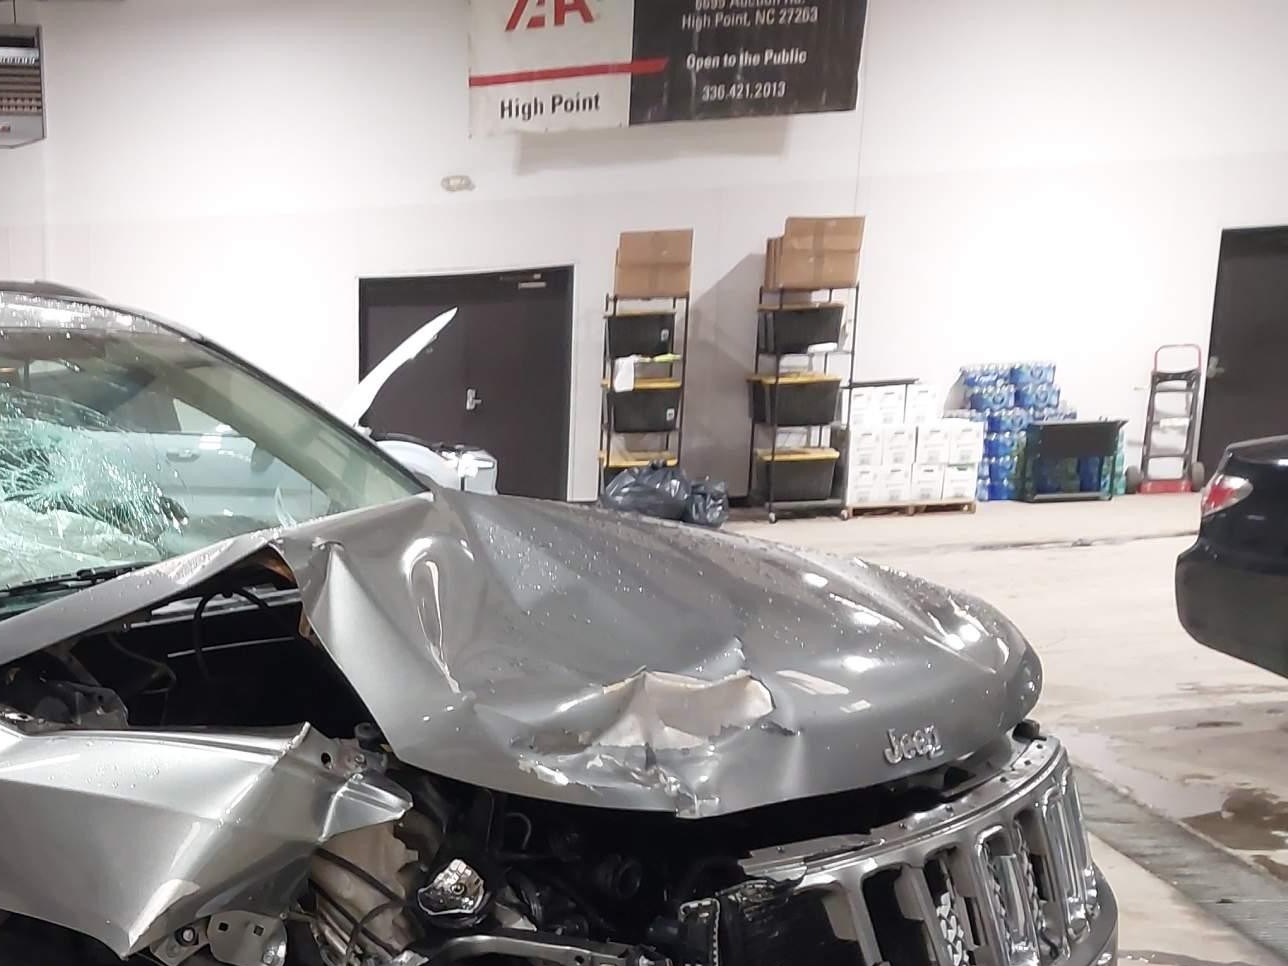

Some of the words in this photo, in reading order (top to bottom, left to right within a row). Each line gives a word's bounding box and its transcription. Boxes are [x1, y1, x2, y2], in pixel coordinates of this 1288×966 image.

[681, 13, 711, 32] High
[714, 10, 752, 28] Point,
[755, 8, 775, 25] NC
[686, 52, 721, 72] Open
[723, 52, 737, 68] to
[739, 49, 761, 67] the
[764, 47, 808, 66] Public
[500, 96, 544, 121] High
[551, 91, 601, 115] Point
[883, 724, 945, 764] Jeep
